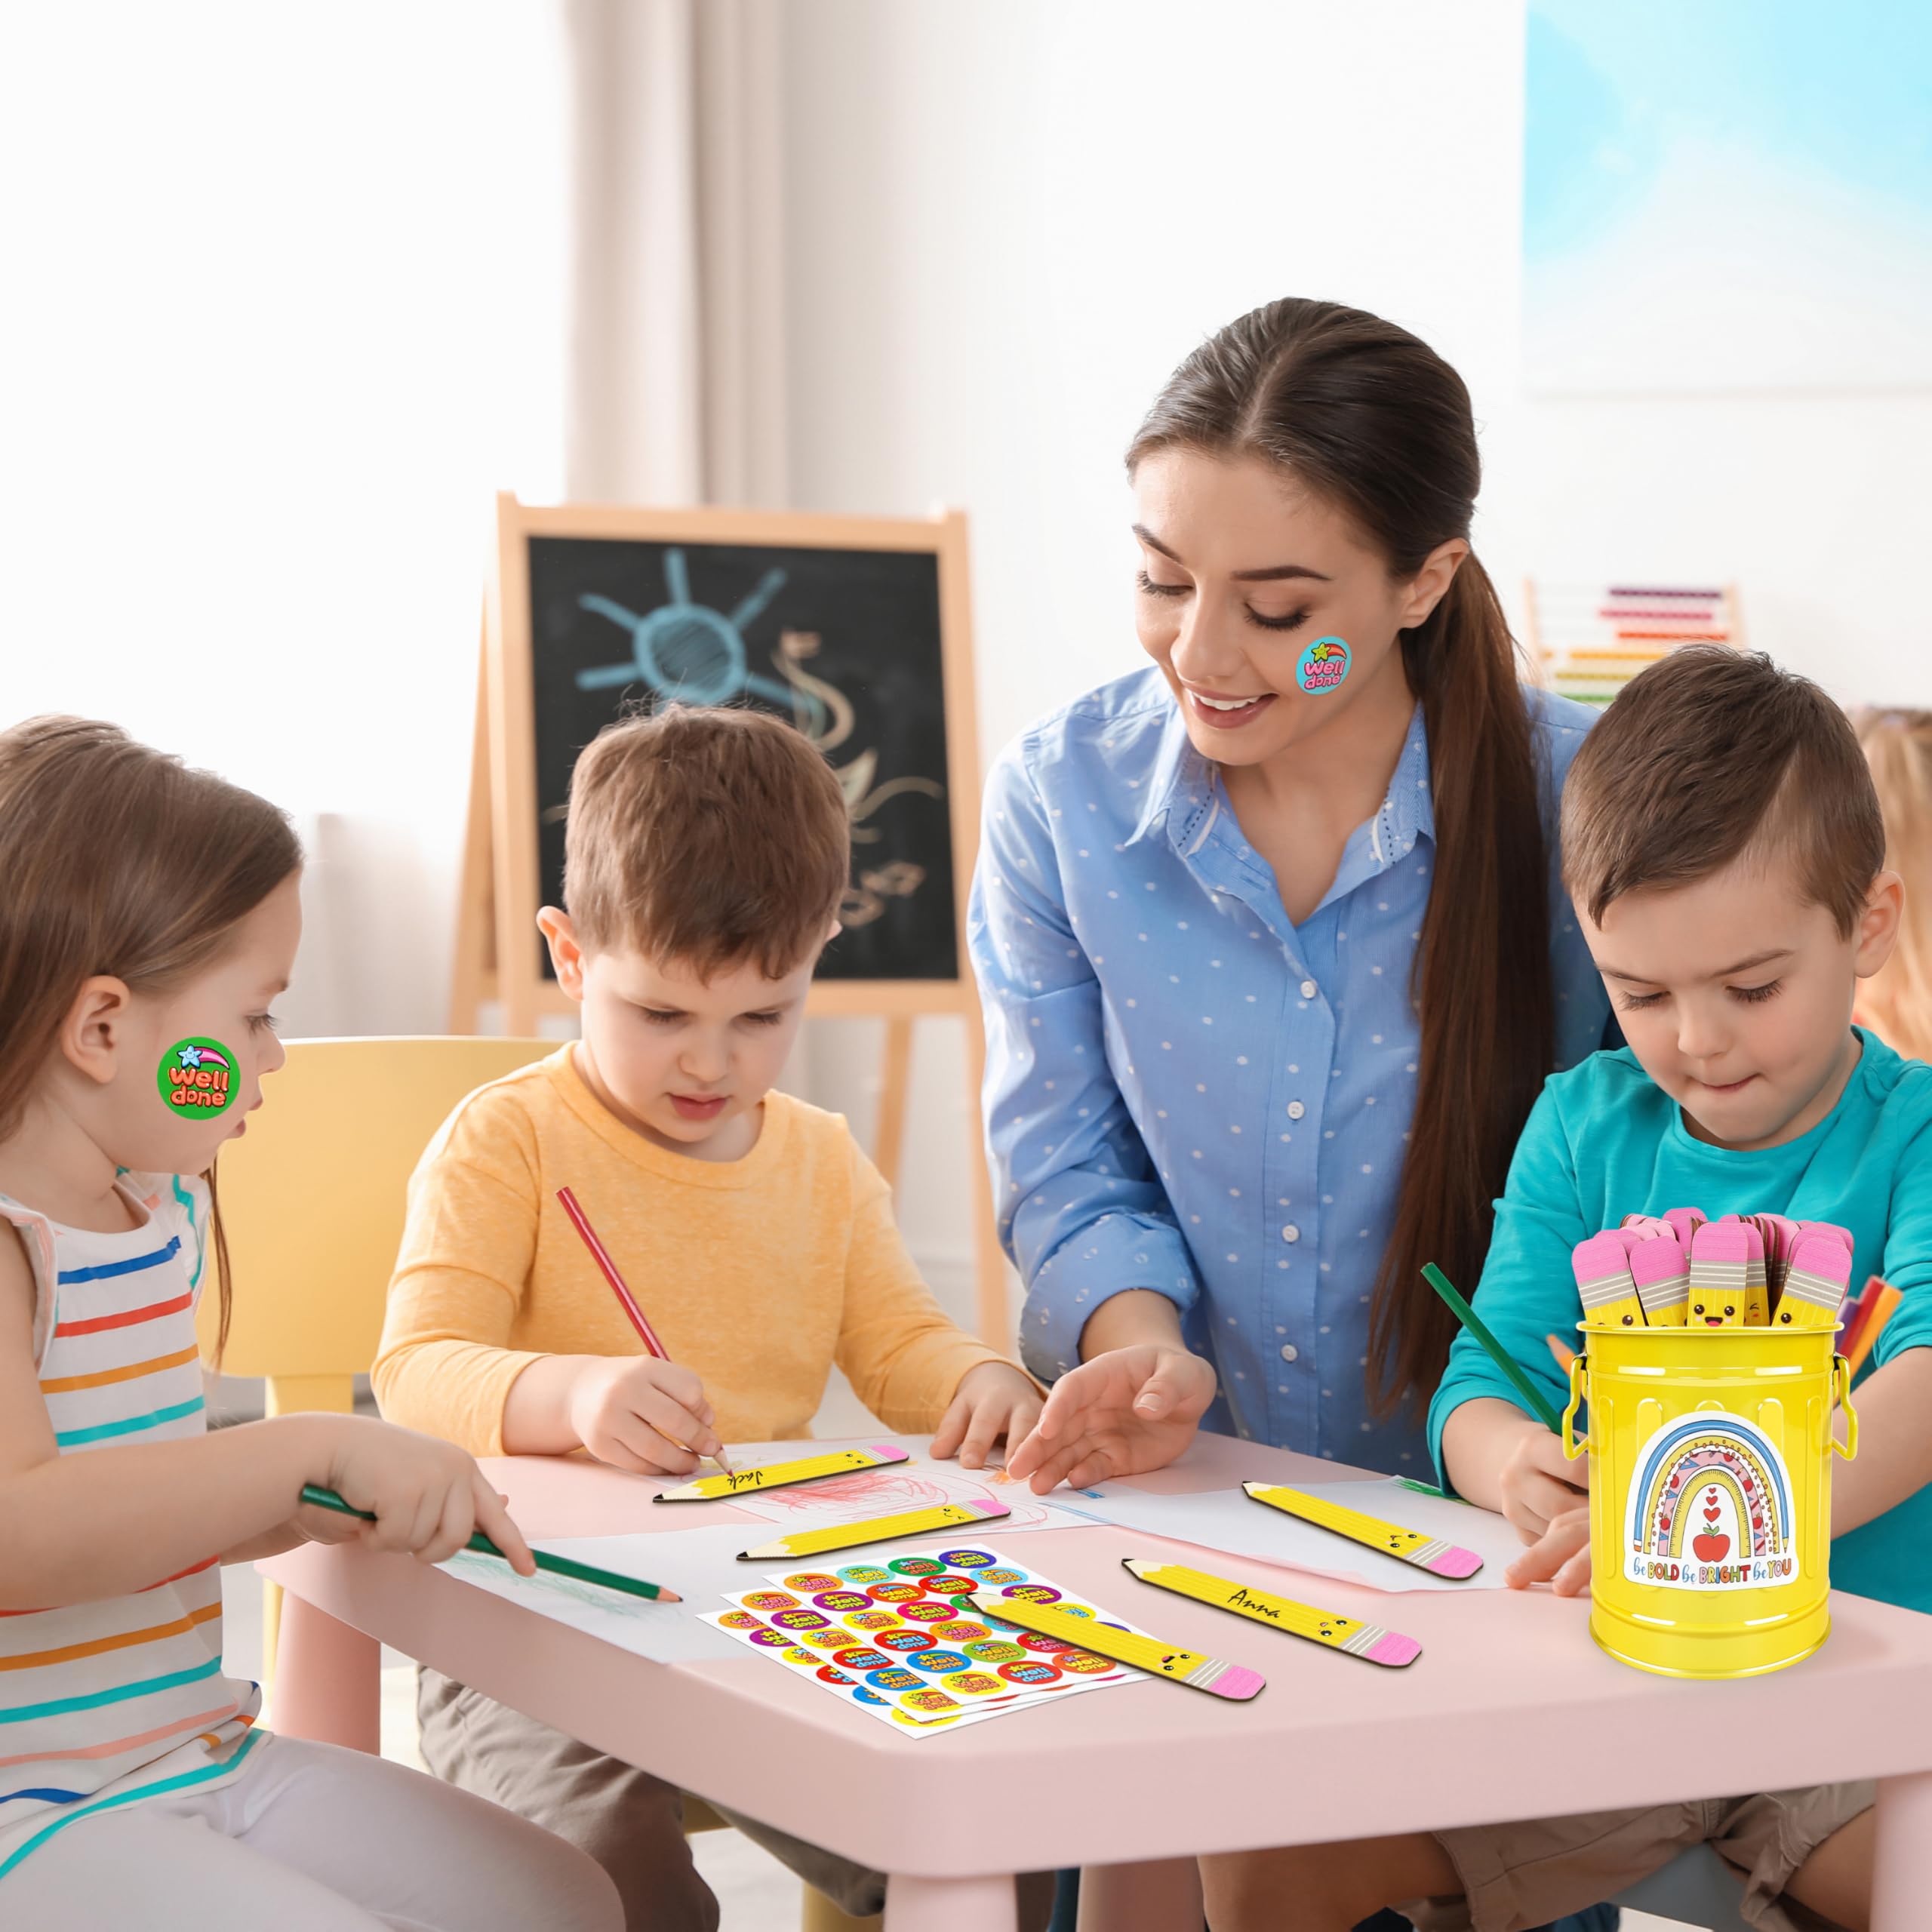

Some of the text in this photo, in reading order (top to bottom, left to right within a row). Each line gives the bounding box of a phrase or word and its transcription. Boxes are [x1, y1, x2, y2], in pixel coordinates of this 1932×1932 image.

[1304, 674, 1341, 690] done
[170, 1084, 226, 1107] done
[727, 1471, 763, 1490] Jack
[1633, 1557, 1792, 1583] be BOLD be BRIGHT be YOU
[1227, 1589, 1281, 1618] Anna
